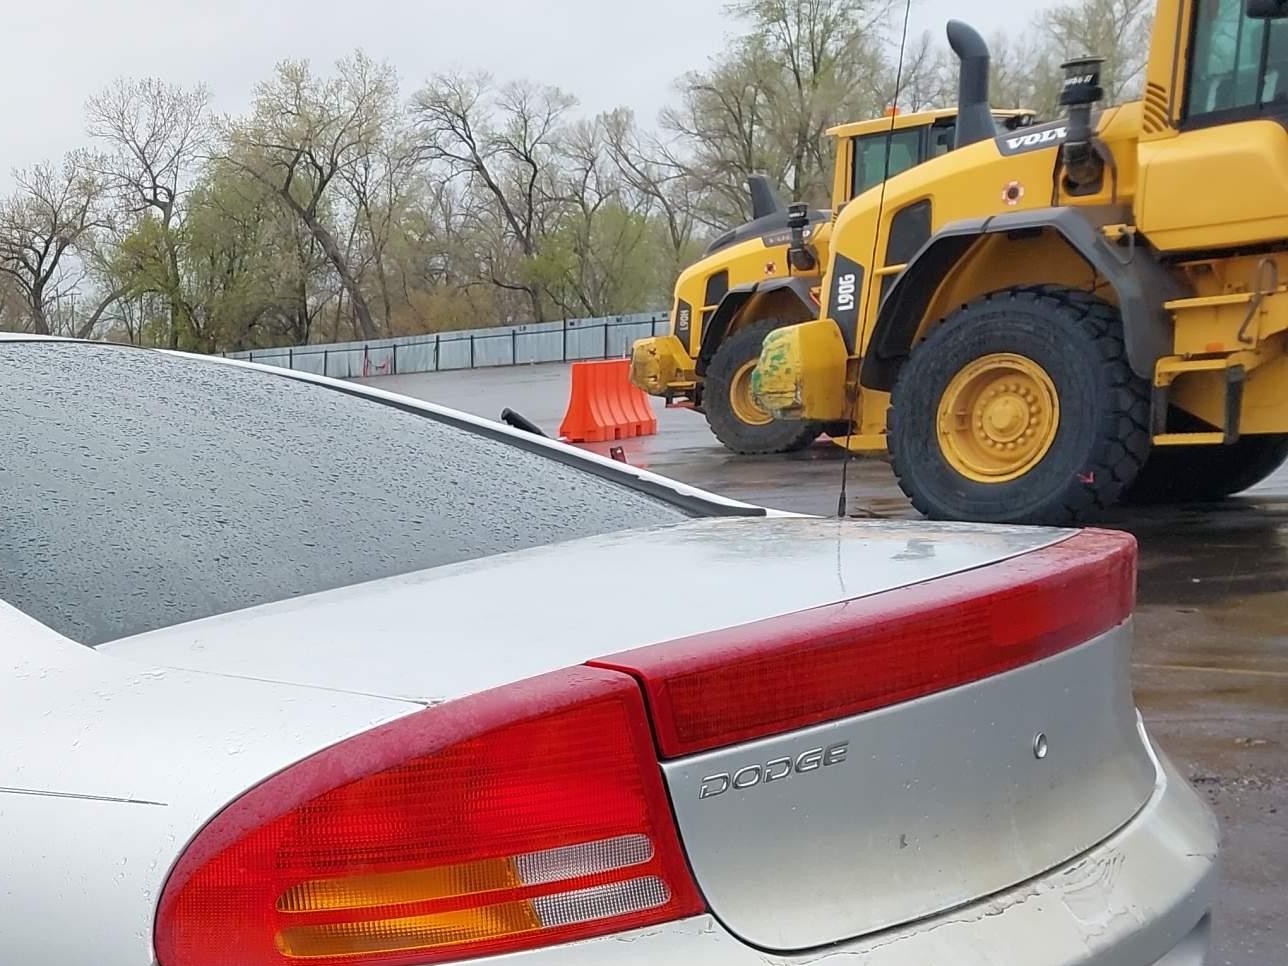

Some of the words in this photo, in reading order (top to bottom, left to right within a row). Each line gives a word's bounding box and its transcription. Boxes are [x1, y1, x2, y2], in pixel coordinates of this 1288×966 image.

[1006, 127, 1067, 150] VOLV
[837, 273, 855, 311] L90G
[699, 741, 849, 800] DODGE
